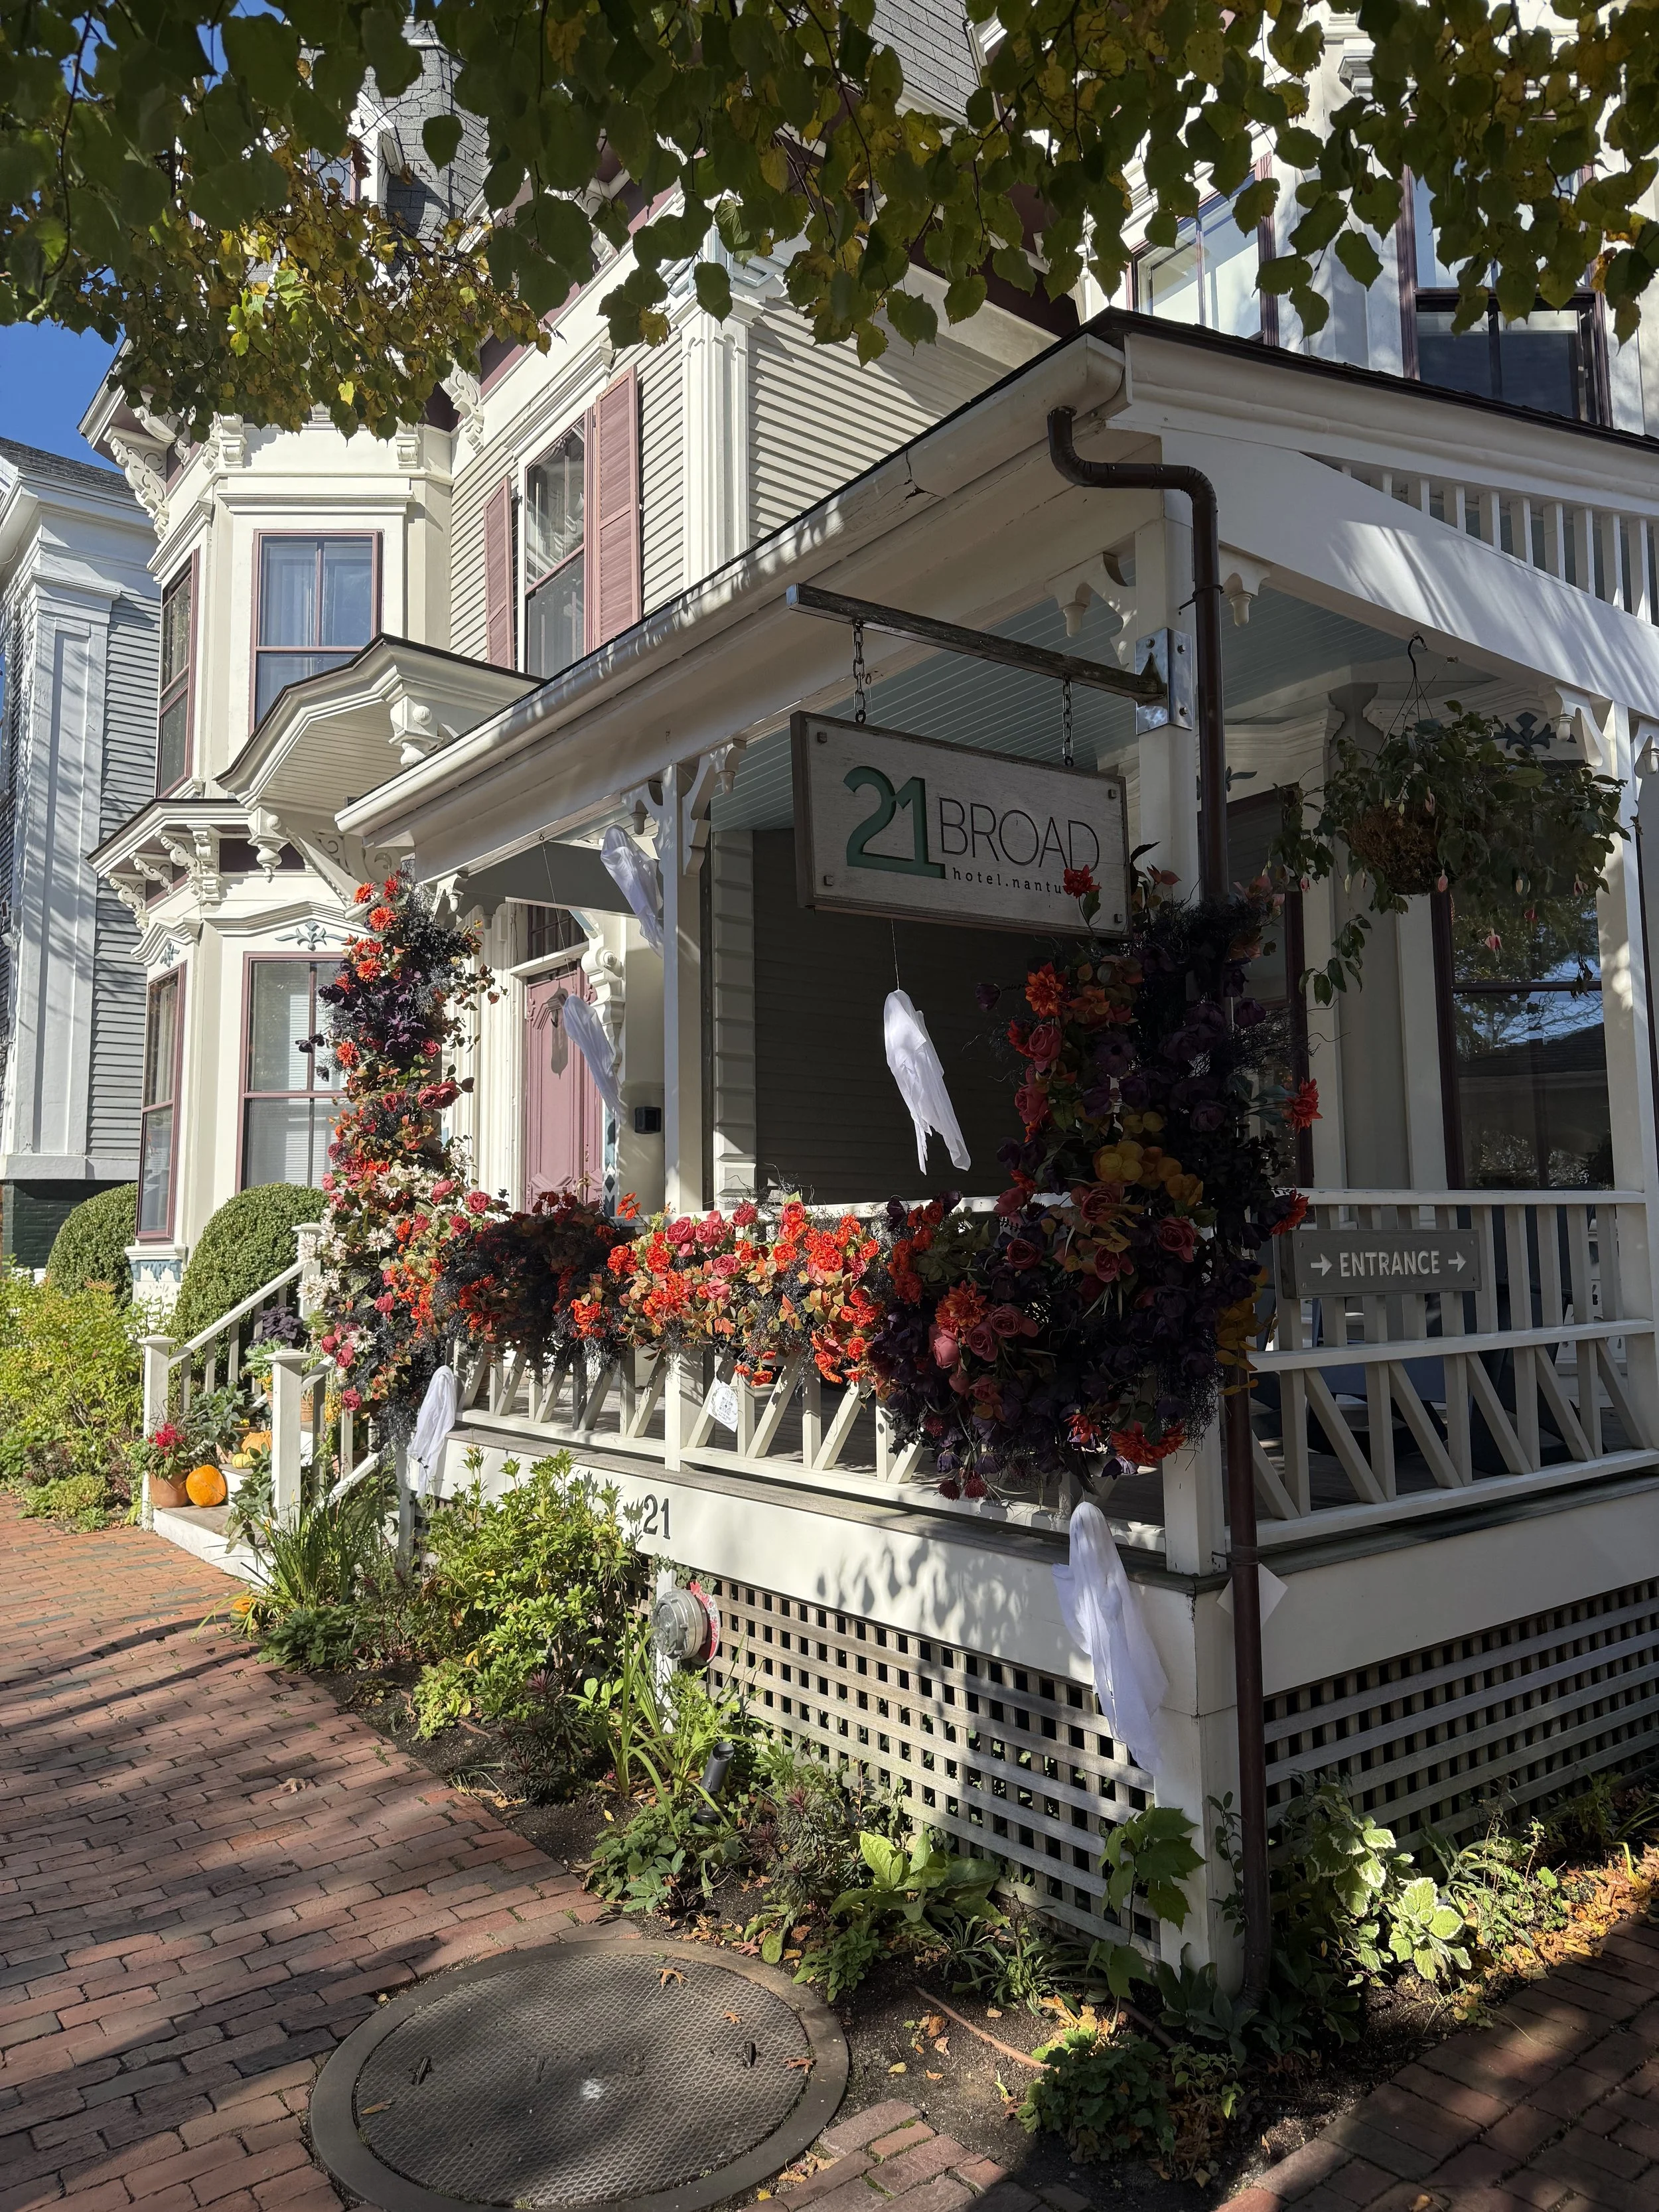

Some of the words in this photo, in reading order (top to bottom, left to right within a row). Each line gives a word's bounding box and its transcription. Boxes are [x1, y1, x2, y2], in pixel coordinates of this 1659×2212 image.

[843, 765, 946, 879] 21
[938, 797, 1100, 873] BROAD
[952, 867, 1064, 895] hotel.nantu
[1339, 1250, 1441, 1277] ENTRANCE
[642, 1493, 671, 1540] 21
